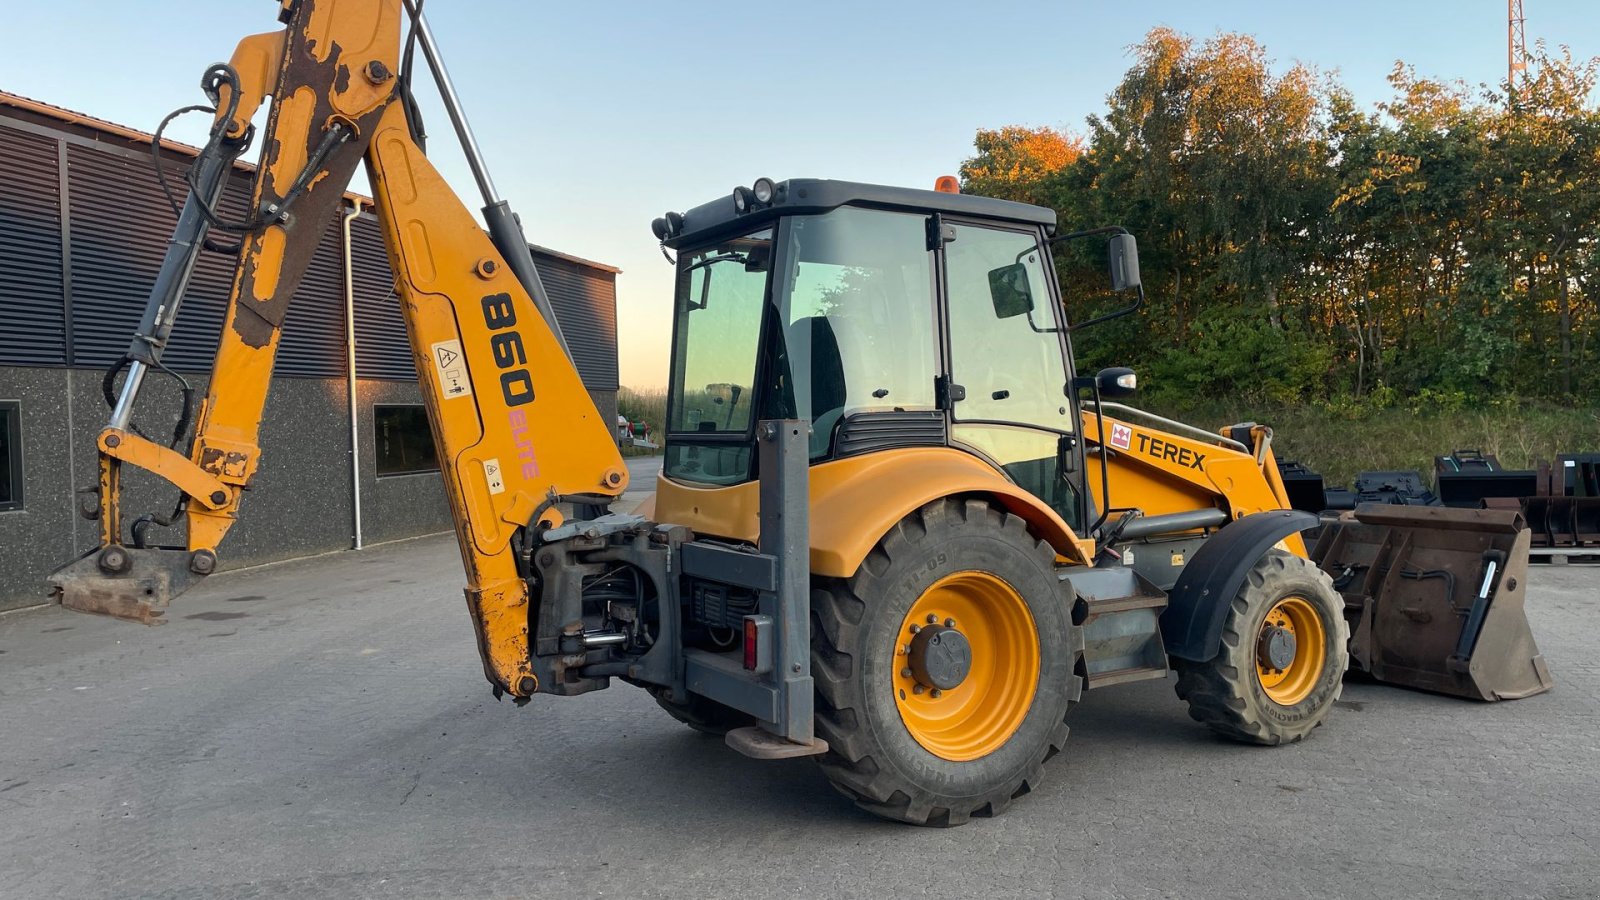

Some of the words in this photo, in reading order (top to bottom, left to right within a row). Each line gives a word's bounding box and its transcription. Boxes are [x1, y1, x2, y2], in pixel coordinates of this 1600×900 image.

[481, 292, 535, 407] 860
[509, 409, 541, 480] ELITE
[1137, 433, 1206, 472] TEREX
